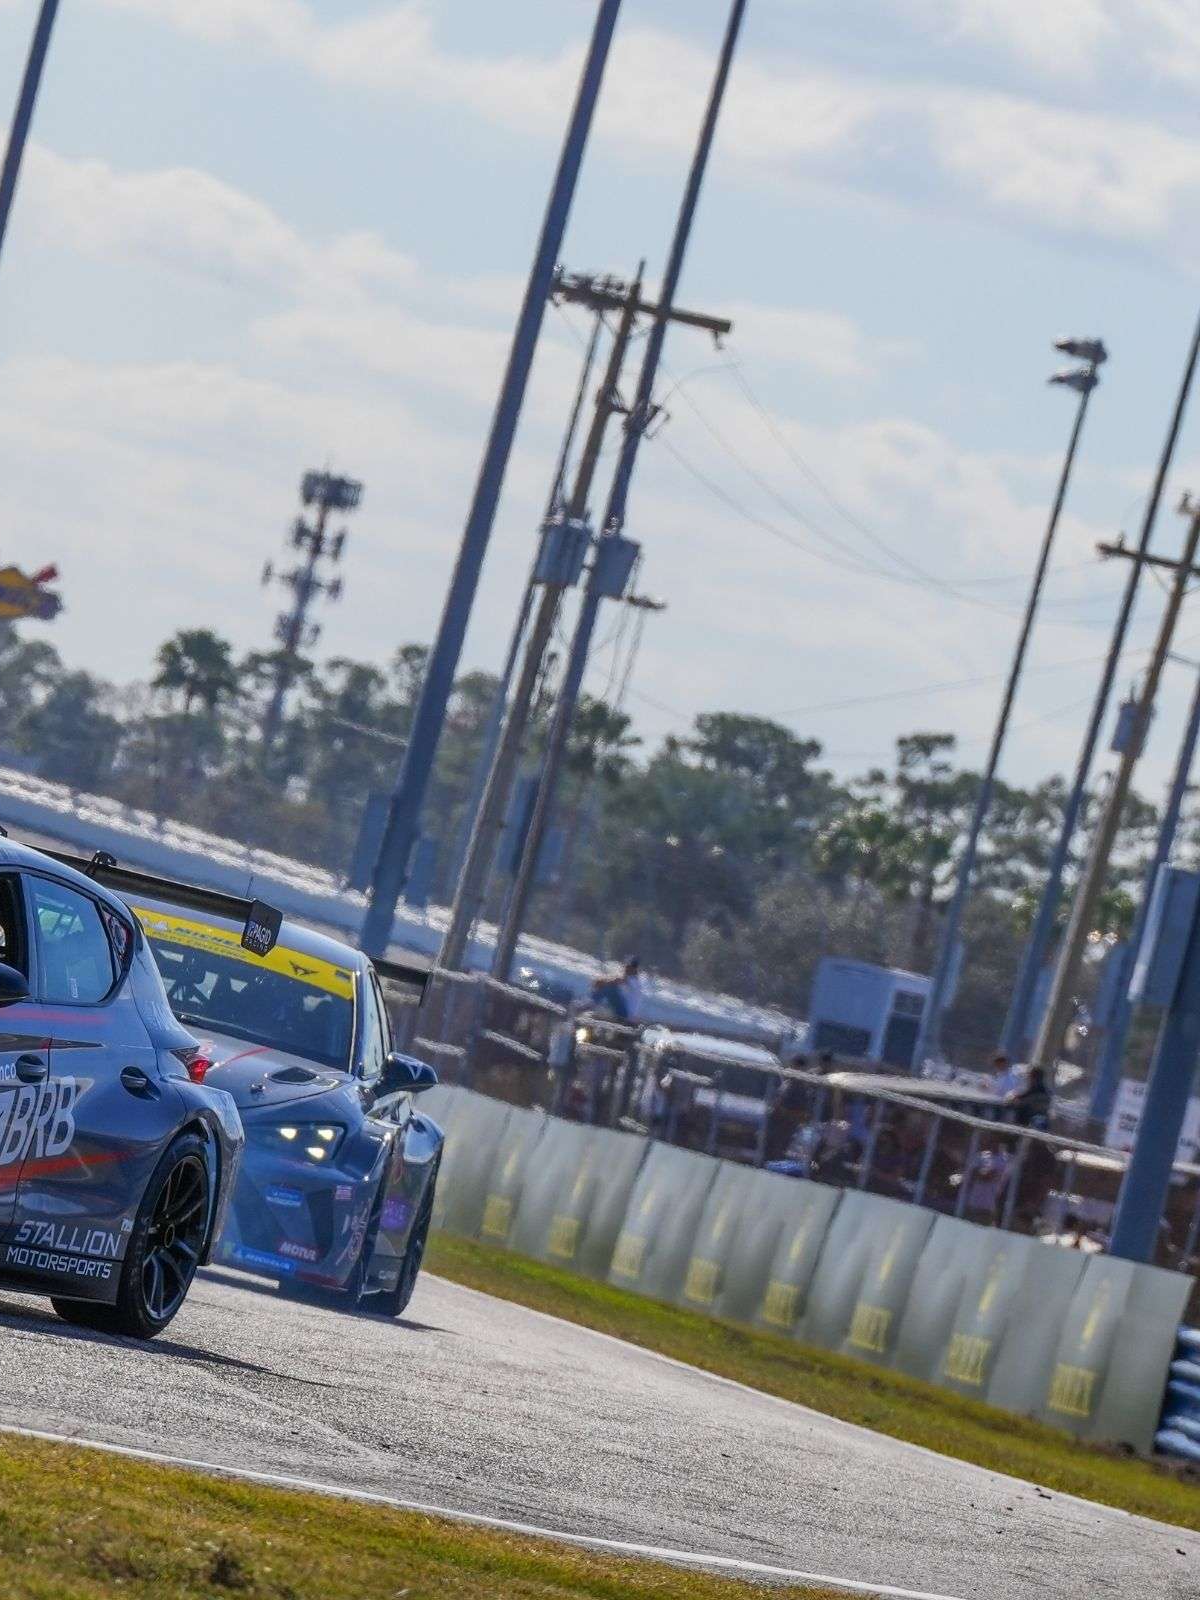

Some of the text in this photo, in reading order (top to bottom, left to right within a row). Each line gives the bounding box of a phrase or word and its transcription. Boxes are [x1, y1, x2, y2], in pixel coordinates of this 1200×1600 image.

[0, 1076, 76, 1166] BRB
[14, 1219, 122, 1258] STALLION
[5, 1245, 113, 1279] MOTORSPORTS
